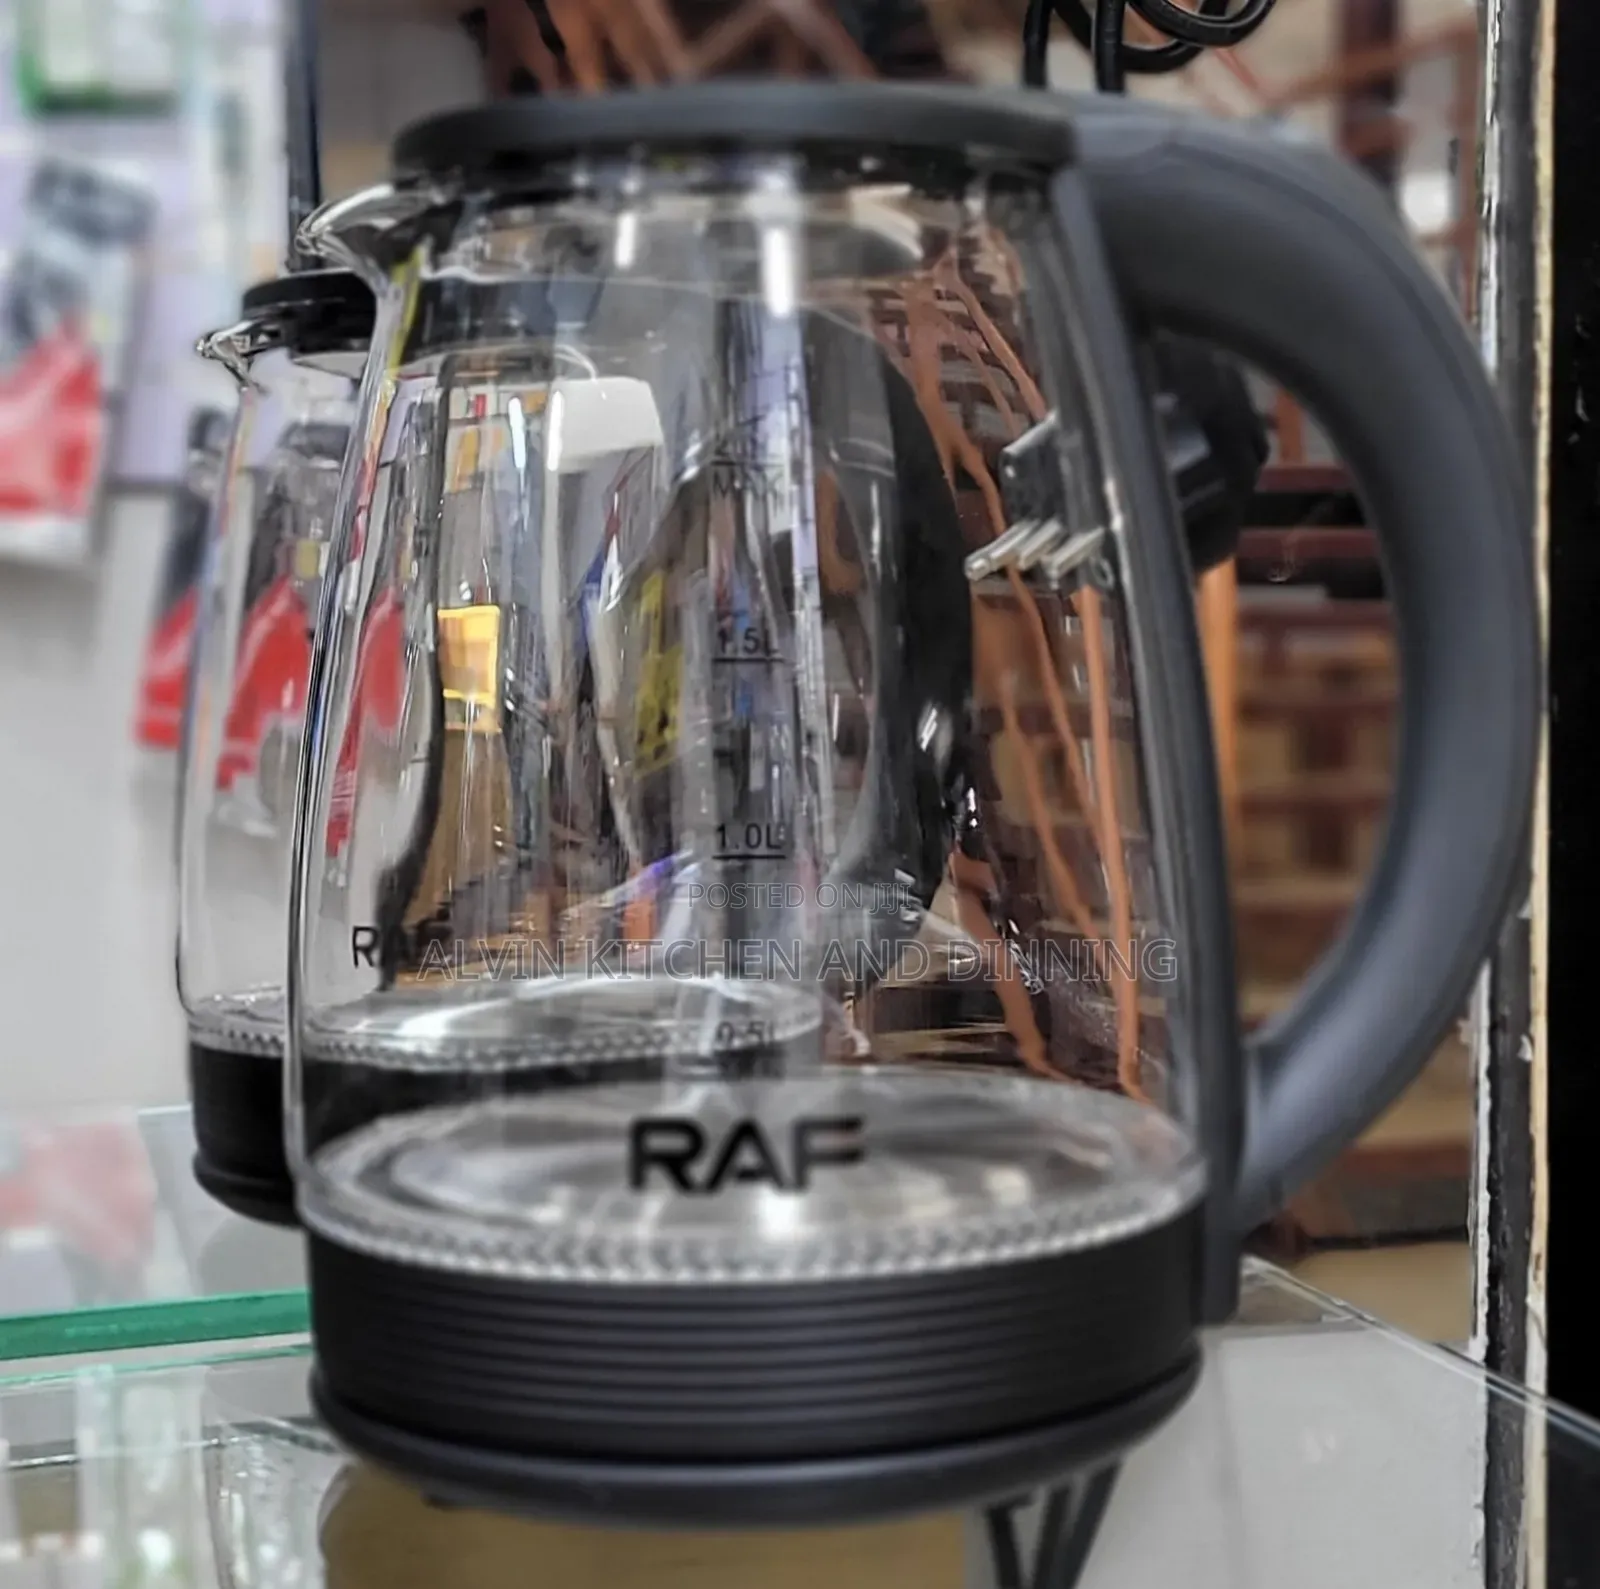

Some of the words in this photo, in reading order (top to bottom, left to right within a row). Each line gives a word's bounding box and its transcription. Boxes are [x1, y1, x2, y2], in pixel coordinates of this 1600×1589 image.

[717, 627, 780, 657] 1.5L
[716, 823, 782, 850] 1.0L
[629, 1115, 864, 1196] RAF
